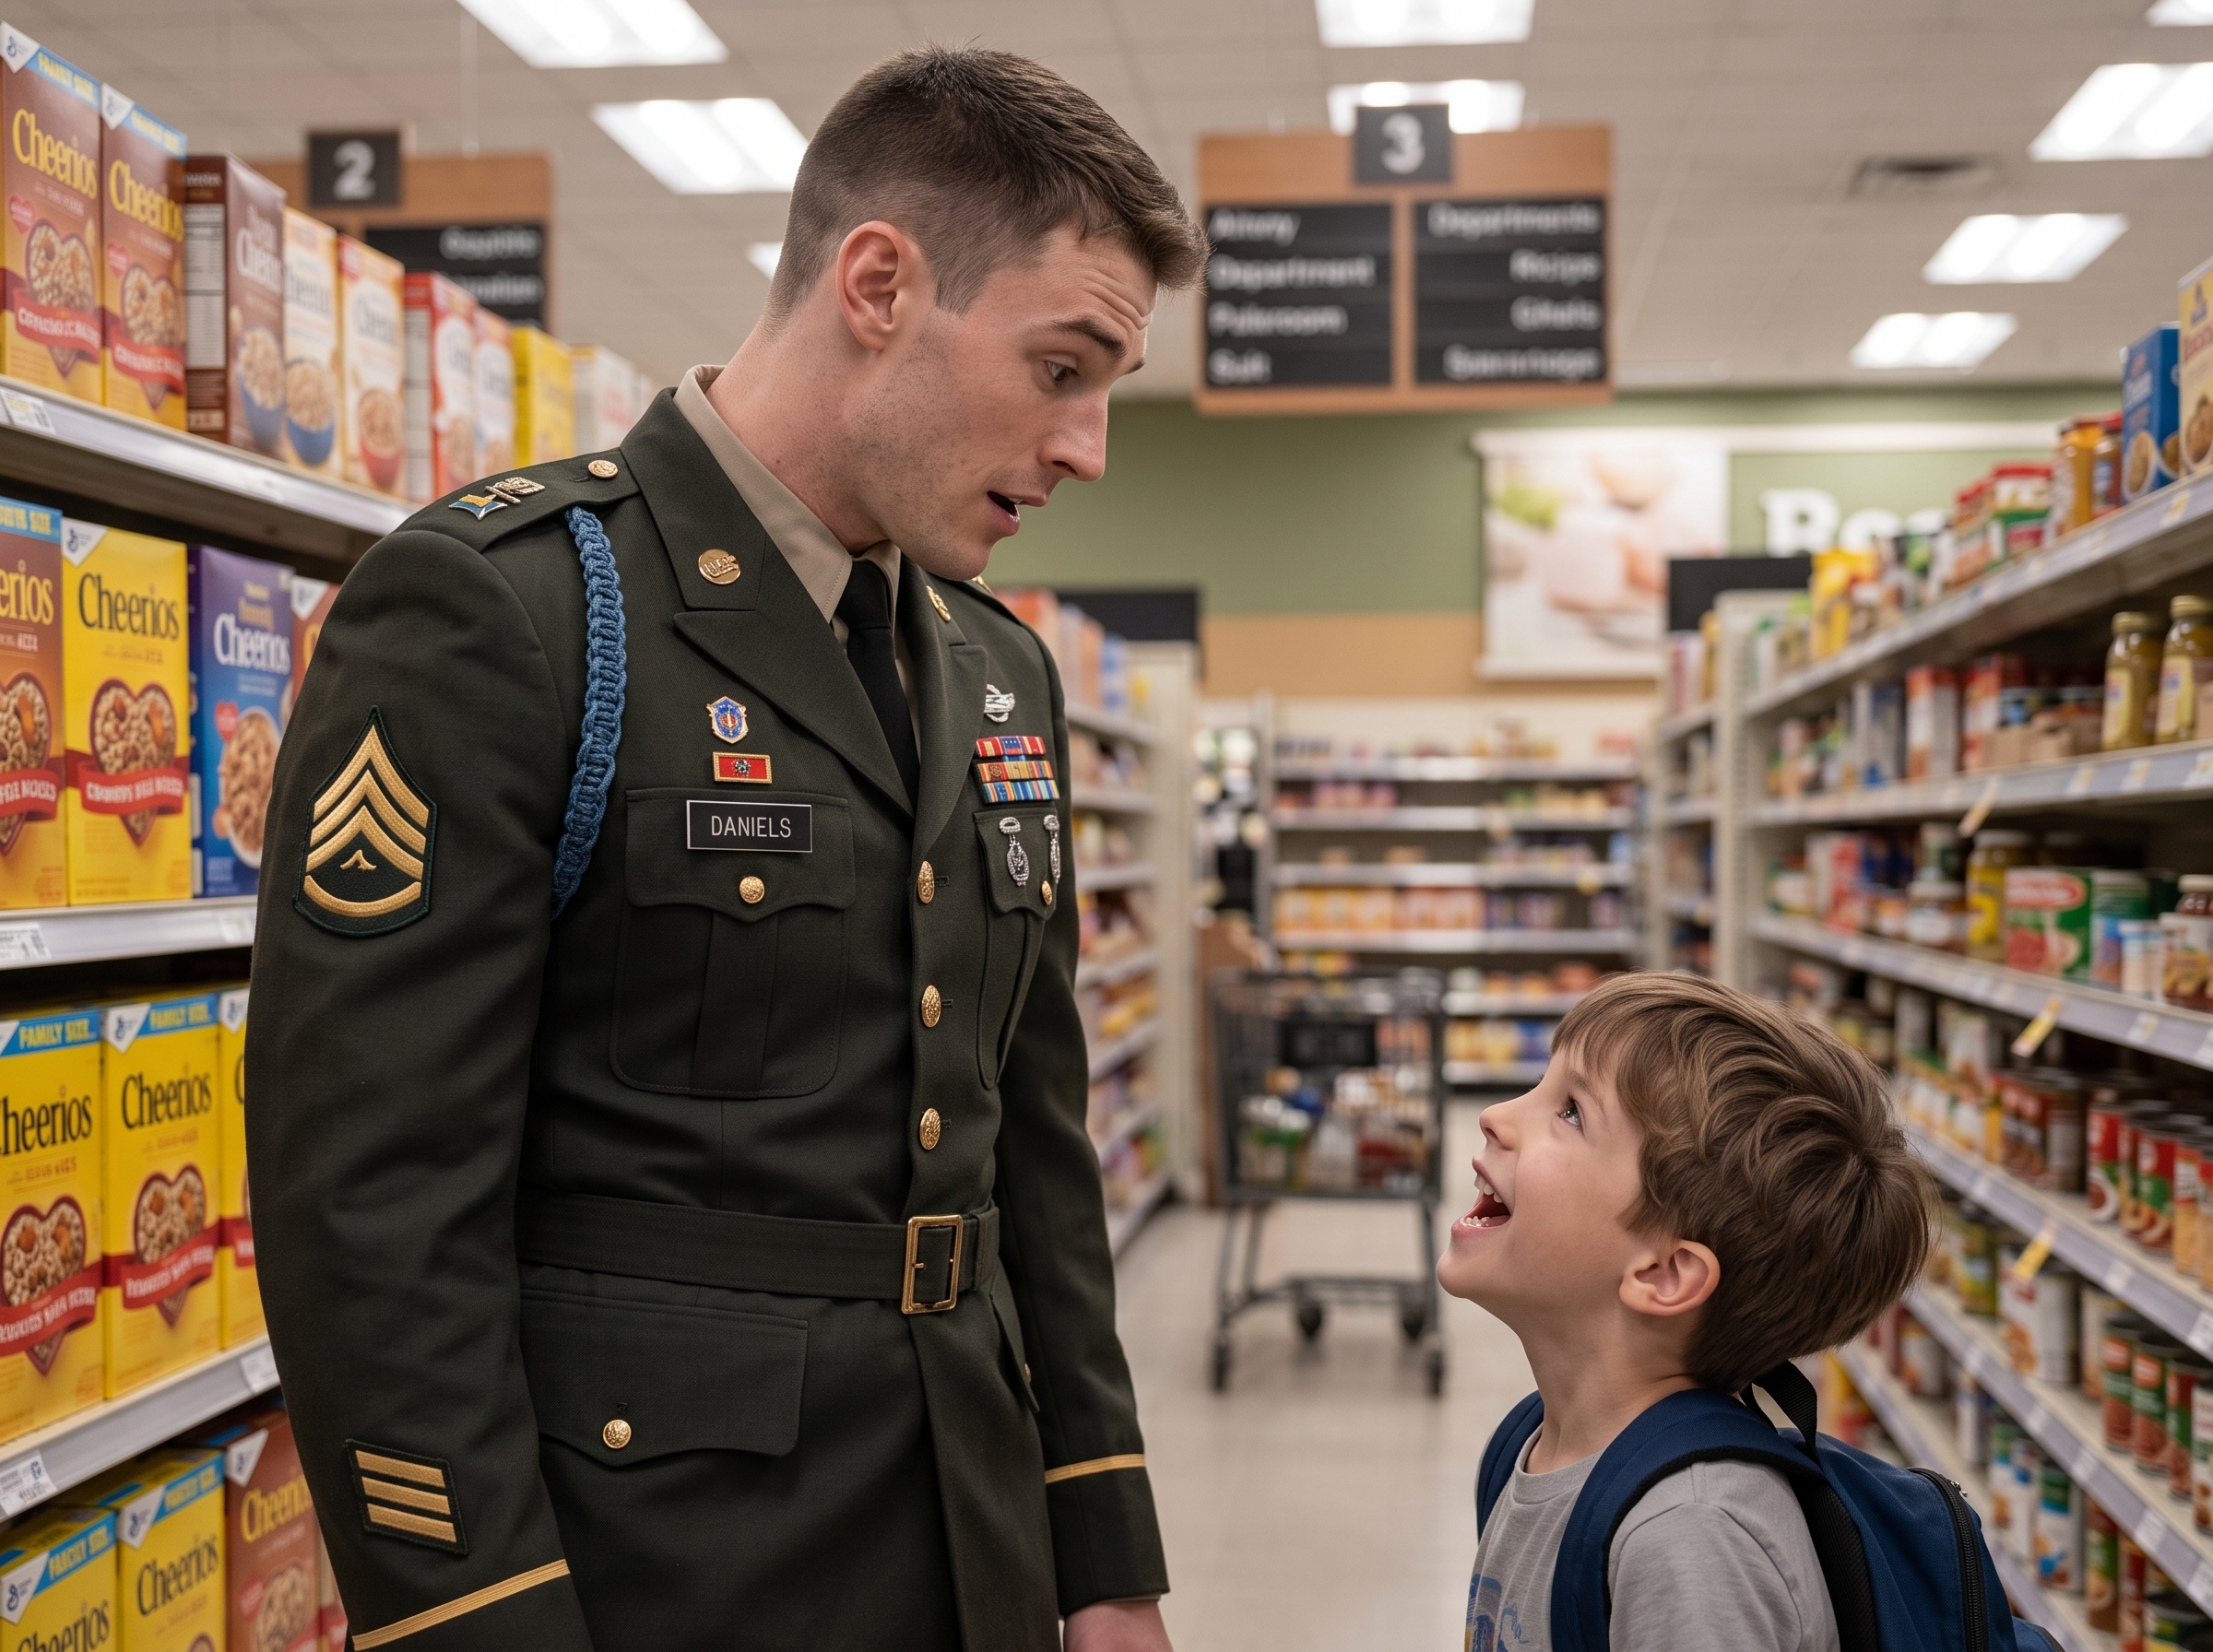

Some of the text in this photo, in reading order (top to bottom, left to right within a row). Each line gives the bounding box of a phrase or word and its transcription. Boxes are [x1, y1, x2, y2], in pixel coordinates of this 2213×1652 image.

[12, 108, 98, 200] Cheerios
[334, 141, 375, 200] 2
[1381, 112, 1425, 174] 3
[78, 572, 181, 642] Cheerios
[213, 612, 291, 676] Cheerios
[711, 815, 792, 838] DANIELS
[0, 1085, 92, 1158] heerios
[121, 1064, 212, 1130] Cheerios
[136, 1532, 220, 1618] Cheerios
[17, 1599, 110, 1652] eerios
